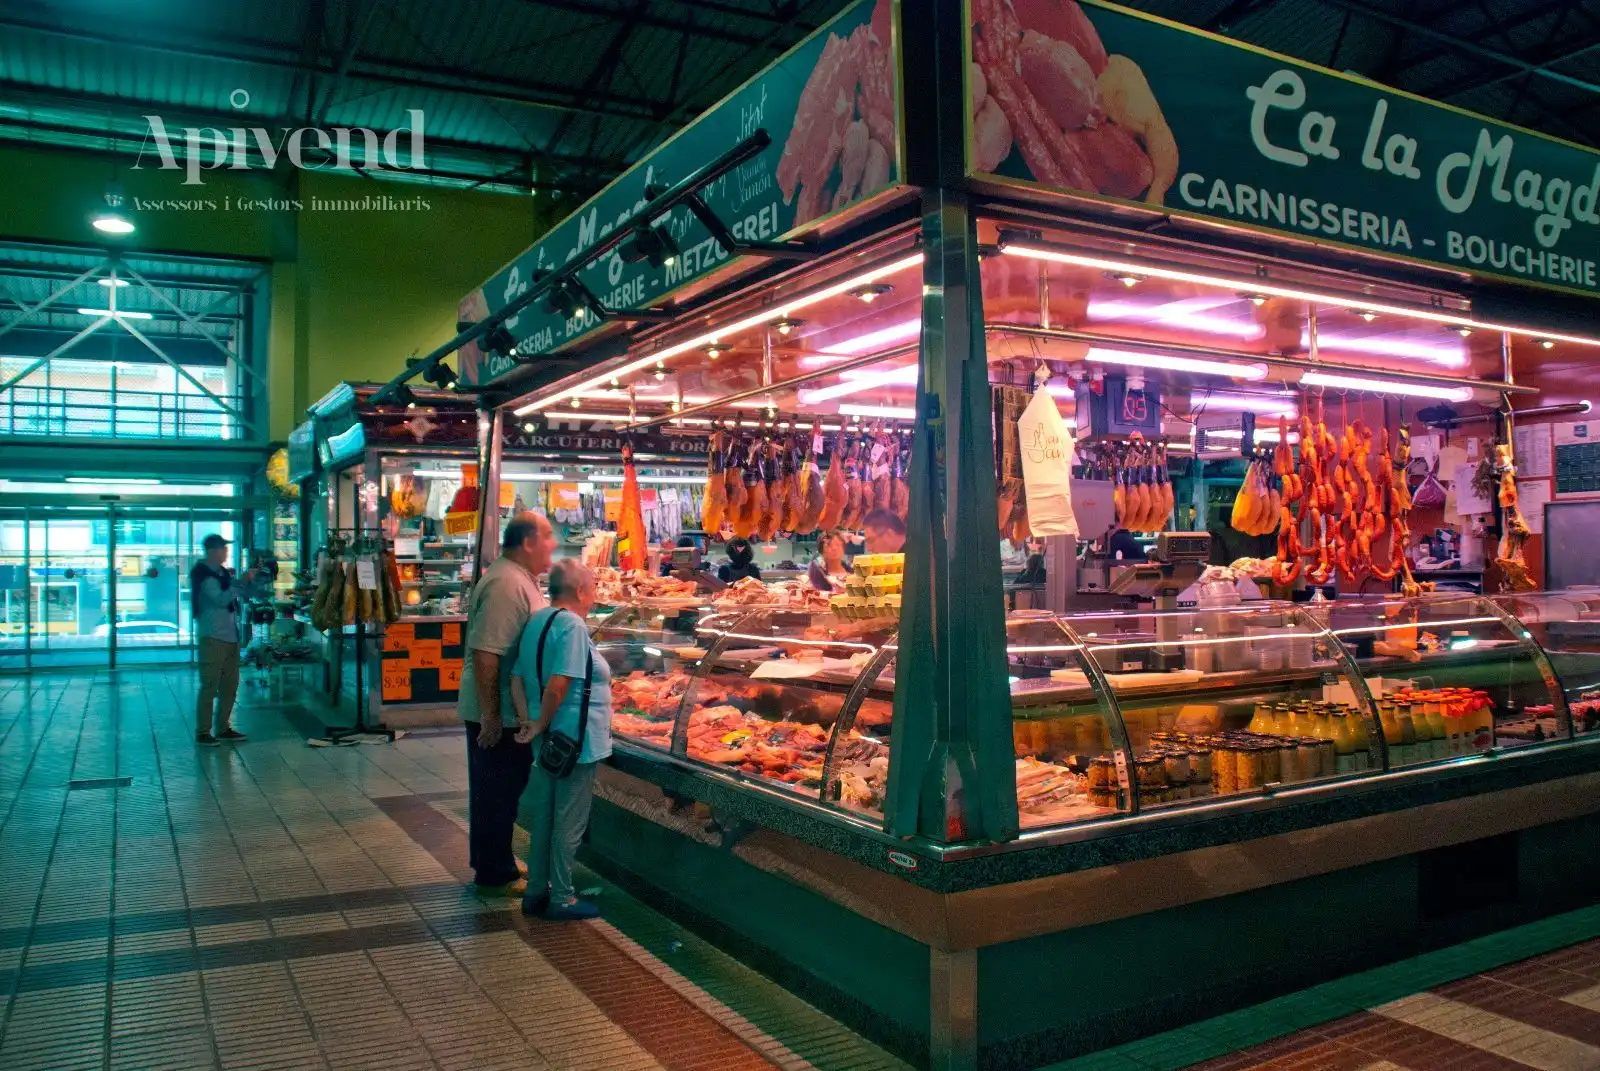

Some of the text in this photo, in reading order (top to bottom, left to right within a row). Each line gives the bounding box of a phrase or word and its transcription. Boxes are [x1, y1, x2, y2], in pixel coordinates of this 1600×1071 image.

[1245, 69, 1339, 167] Ca
[1361, 98, 1421, 180] la
[1179, 173, 1413, 250] CARNISSERIA
[1446, 230, 1597, 287] BOUCHERIE
